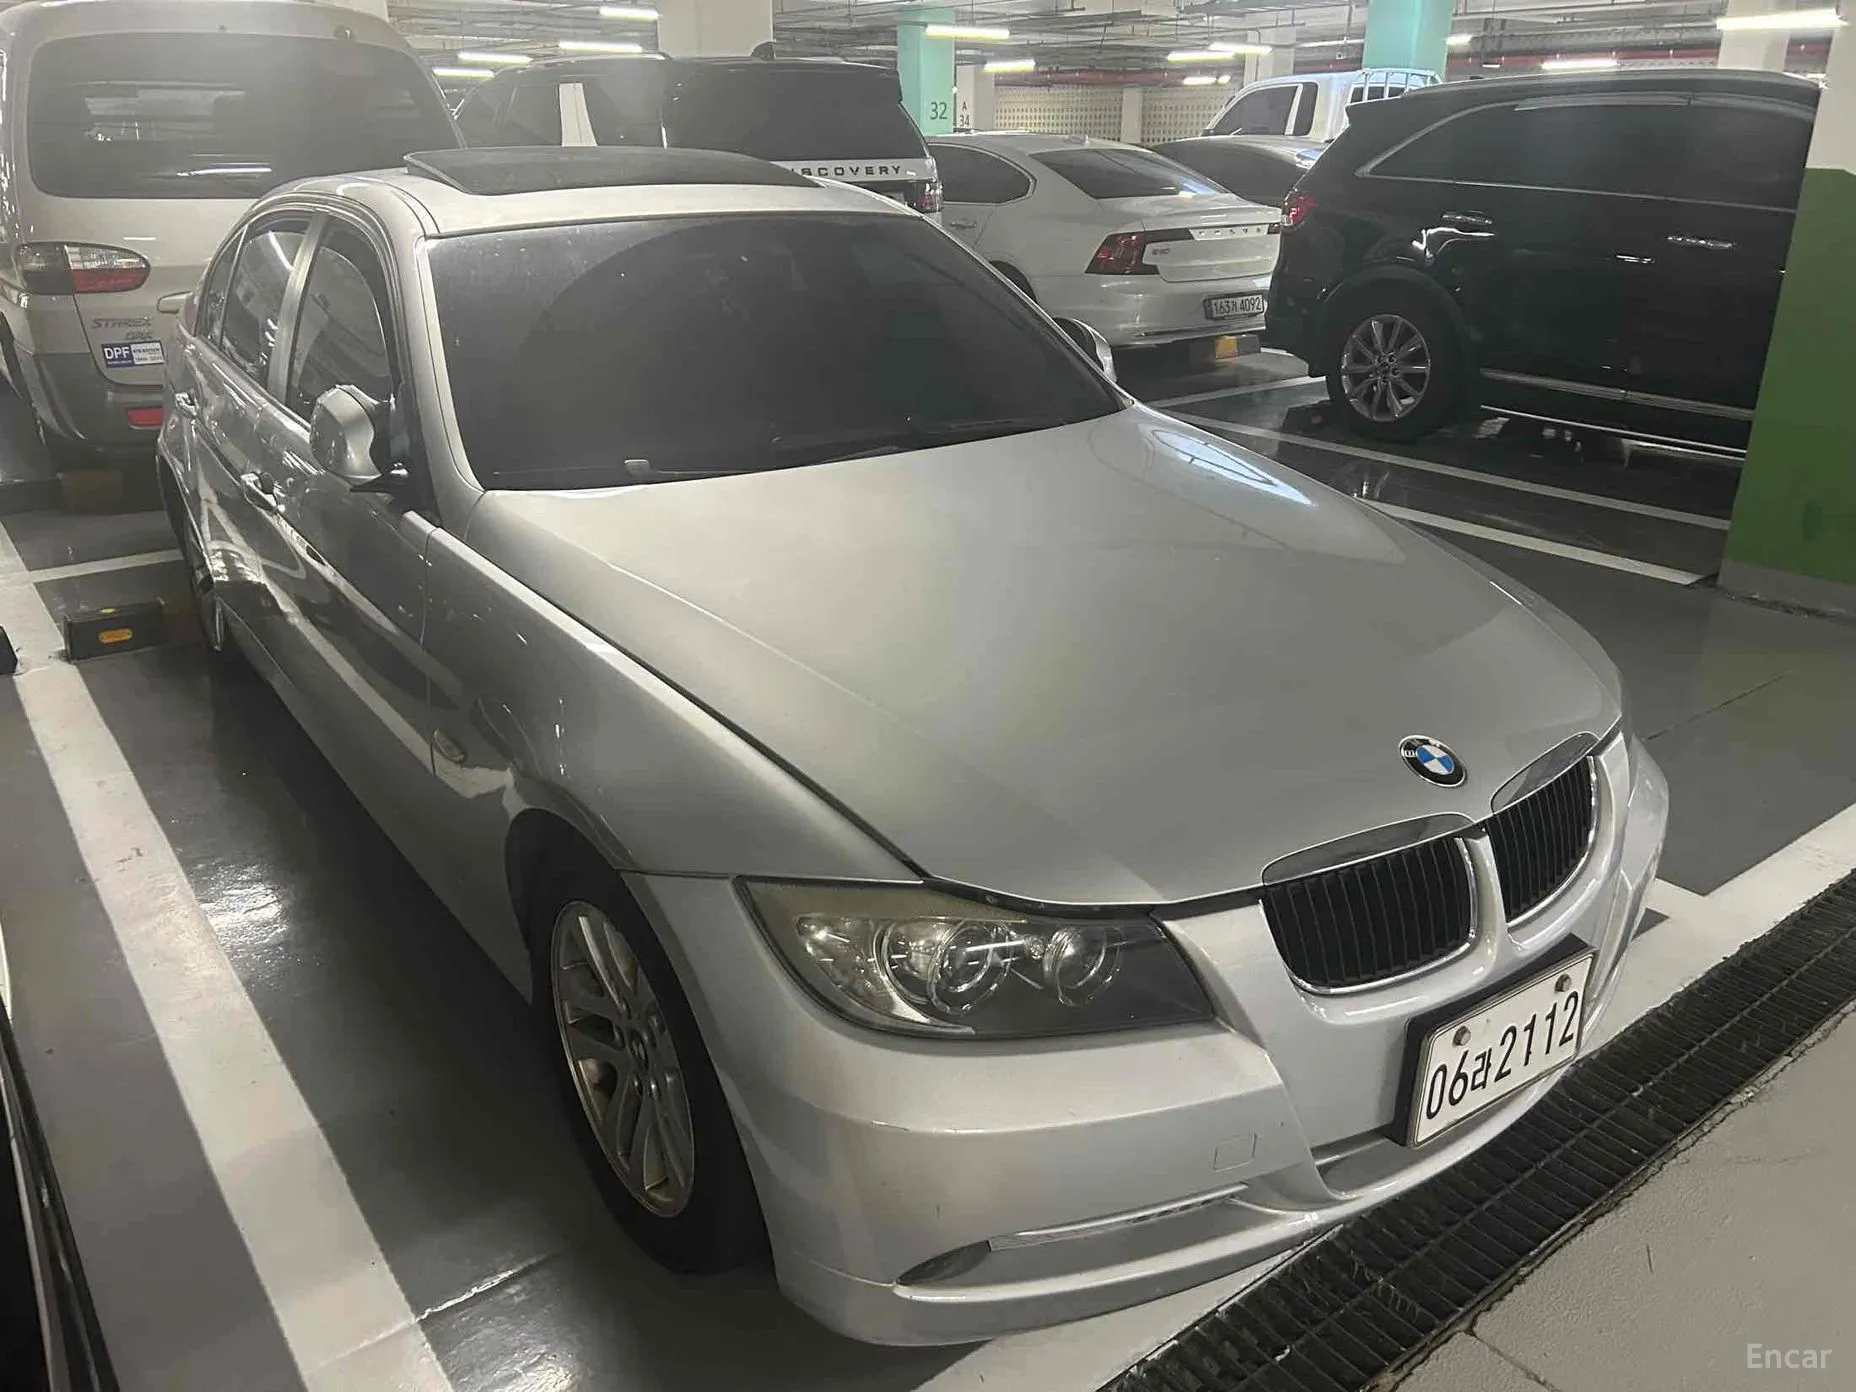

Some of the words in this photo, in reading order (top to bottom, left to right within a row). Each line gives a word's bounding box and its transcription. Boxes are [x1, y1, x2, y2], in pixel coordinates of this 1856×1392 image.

[930, 101, 948, 120] 32
[962, 101, 968, 111] A
[959, 115, 970, 127] 34
[103, 346, 130, 359] DPF
[1426, 991, 1579, 1120] 06라2112
